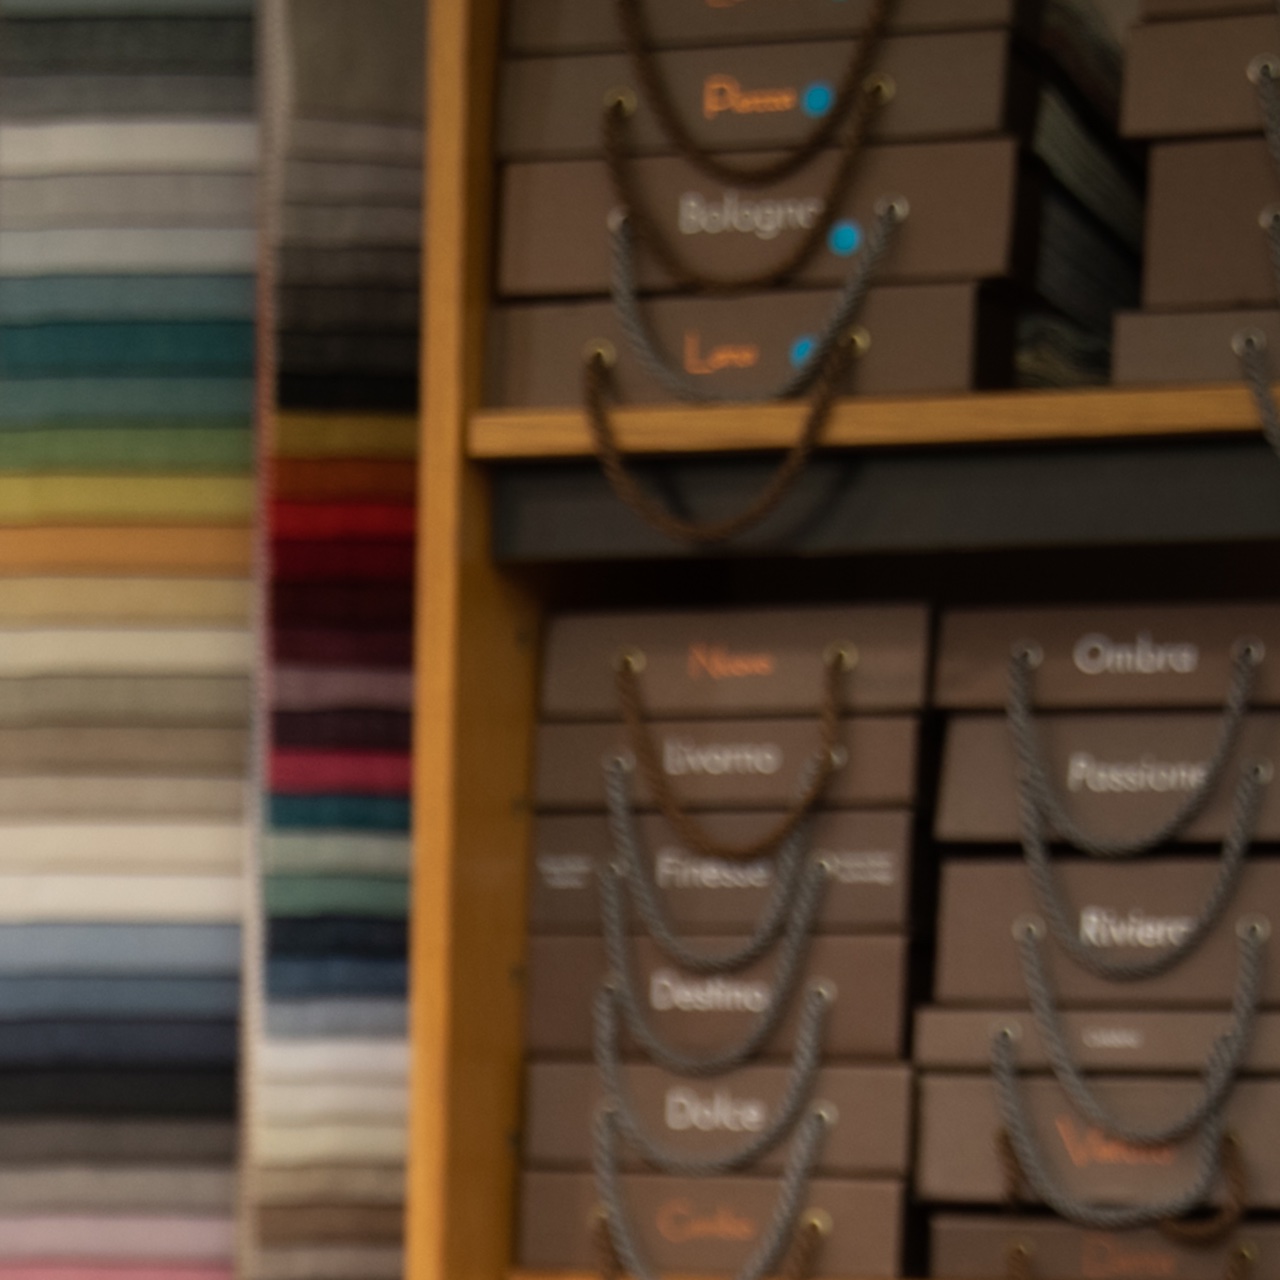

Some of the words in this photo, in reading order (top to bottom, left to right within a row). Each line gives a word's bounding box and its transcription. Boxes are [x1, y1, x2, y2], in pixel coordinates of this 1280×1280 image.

[1072, 630, 1198, 675] Ombra
[655, 856, 772, 891] Finesse
[663, 1090, 765, 1134] Dolce
